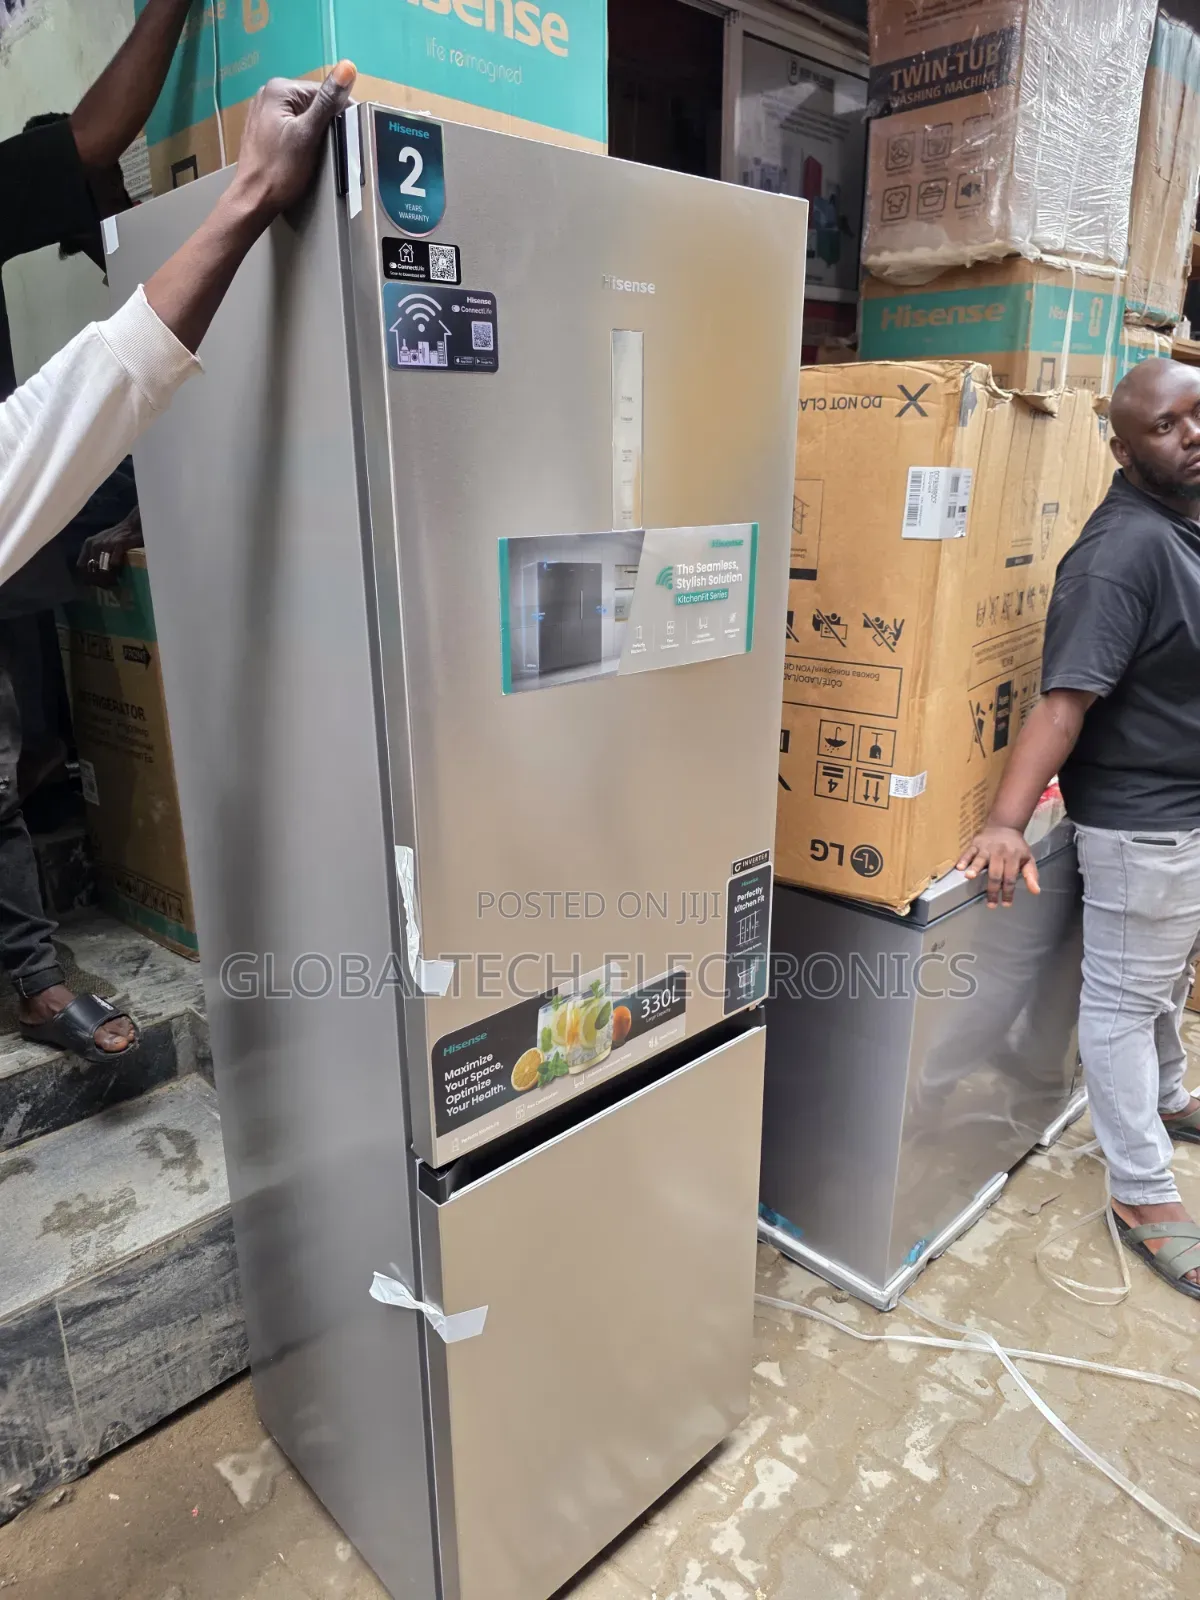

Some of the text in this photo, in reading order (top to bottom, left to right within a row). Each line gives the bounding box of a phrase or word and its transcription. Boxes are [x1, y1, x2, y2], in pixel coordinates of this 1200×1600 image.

[405, 0, 569, 57] ense
[426, 36, 522, 84] life reimagined
[890, 43, 999, 91] TWIN-TUB
[388, 121, 430, 139] Hisense
[398, 146, 426, 198] 2
[398, 211, 430, 222] WARRANTY
[405, 203, 423, 213] YEARS
[602, 273, 656, 294] Hisense
[460, 306, 493, 315] ConnectLife
[466, 296, 492, 305] Hisense
[880, 301, 1006, 331] Hisense
[797, 396, 883, 411] DO NOT CLA
[676, 560, 739, 575] The Seamless,
[676, 572, 743, 590] Stylish Solution
[677, 590, 728, 604] KitchenFit Series
[828, 778, 839, 793] 4
[742, 852, 768, 866] INVERTER
[810, 838, 845, 866] LG
[734, 894, 765, 914] Kitchen Fit
[736, 886, 764, 903] Perfectly
[641, 984, 681, 1019] 330L
[443, 1032, 488, 1056] Hisense
[444, 1053, 493, 1081] Maximize
[445, 1061, 504, 1093] Your Space,
[445, 1078, 492, 1105] Optimize
[446, 1101, 469, 1117] Your
[471, 1083, 507, 1106] Health.
